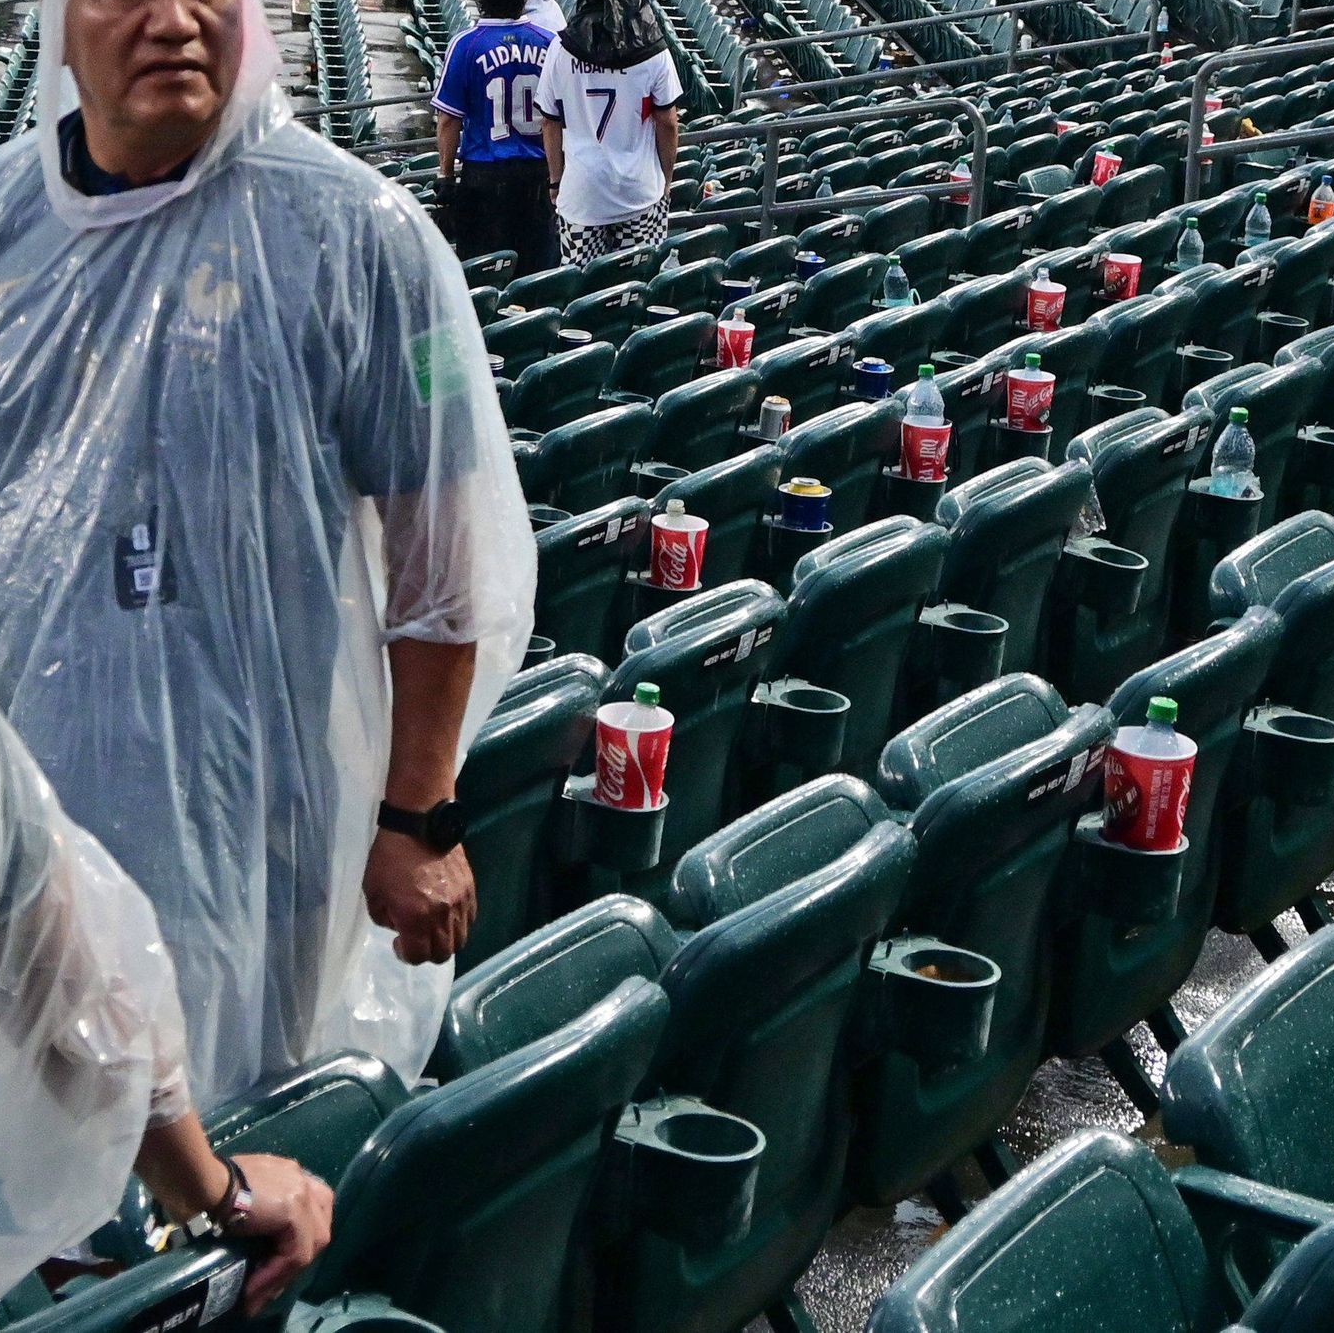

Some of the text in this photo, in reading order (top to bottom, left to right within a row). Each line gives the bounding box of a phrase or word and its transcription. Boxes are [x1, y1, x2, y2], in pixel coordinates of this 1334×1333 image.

[475, 44, 548, 75] ZIDANE
[486, 74, 543, 142] 10
[586, 88, 616, 144] 7
[1012, 389, 1027, 409] IRQ
[920, 439, 938, 458] IRQ
[667, 541, 688, 586] Cola
[601, 742, 627, 801] Cola
[1028, 784, 1047, 801] NEED
